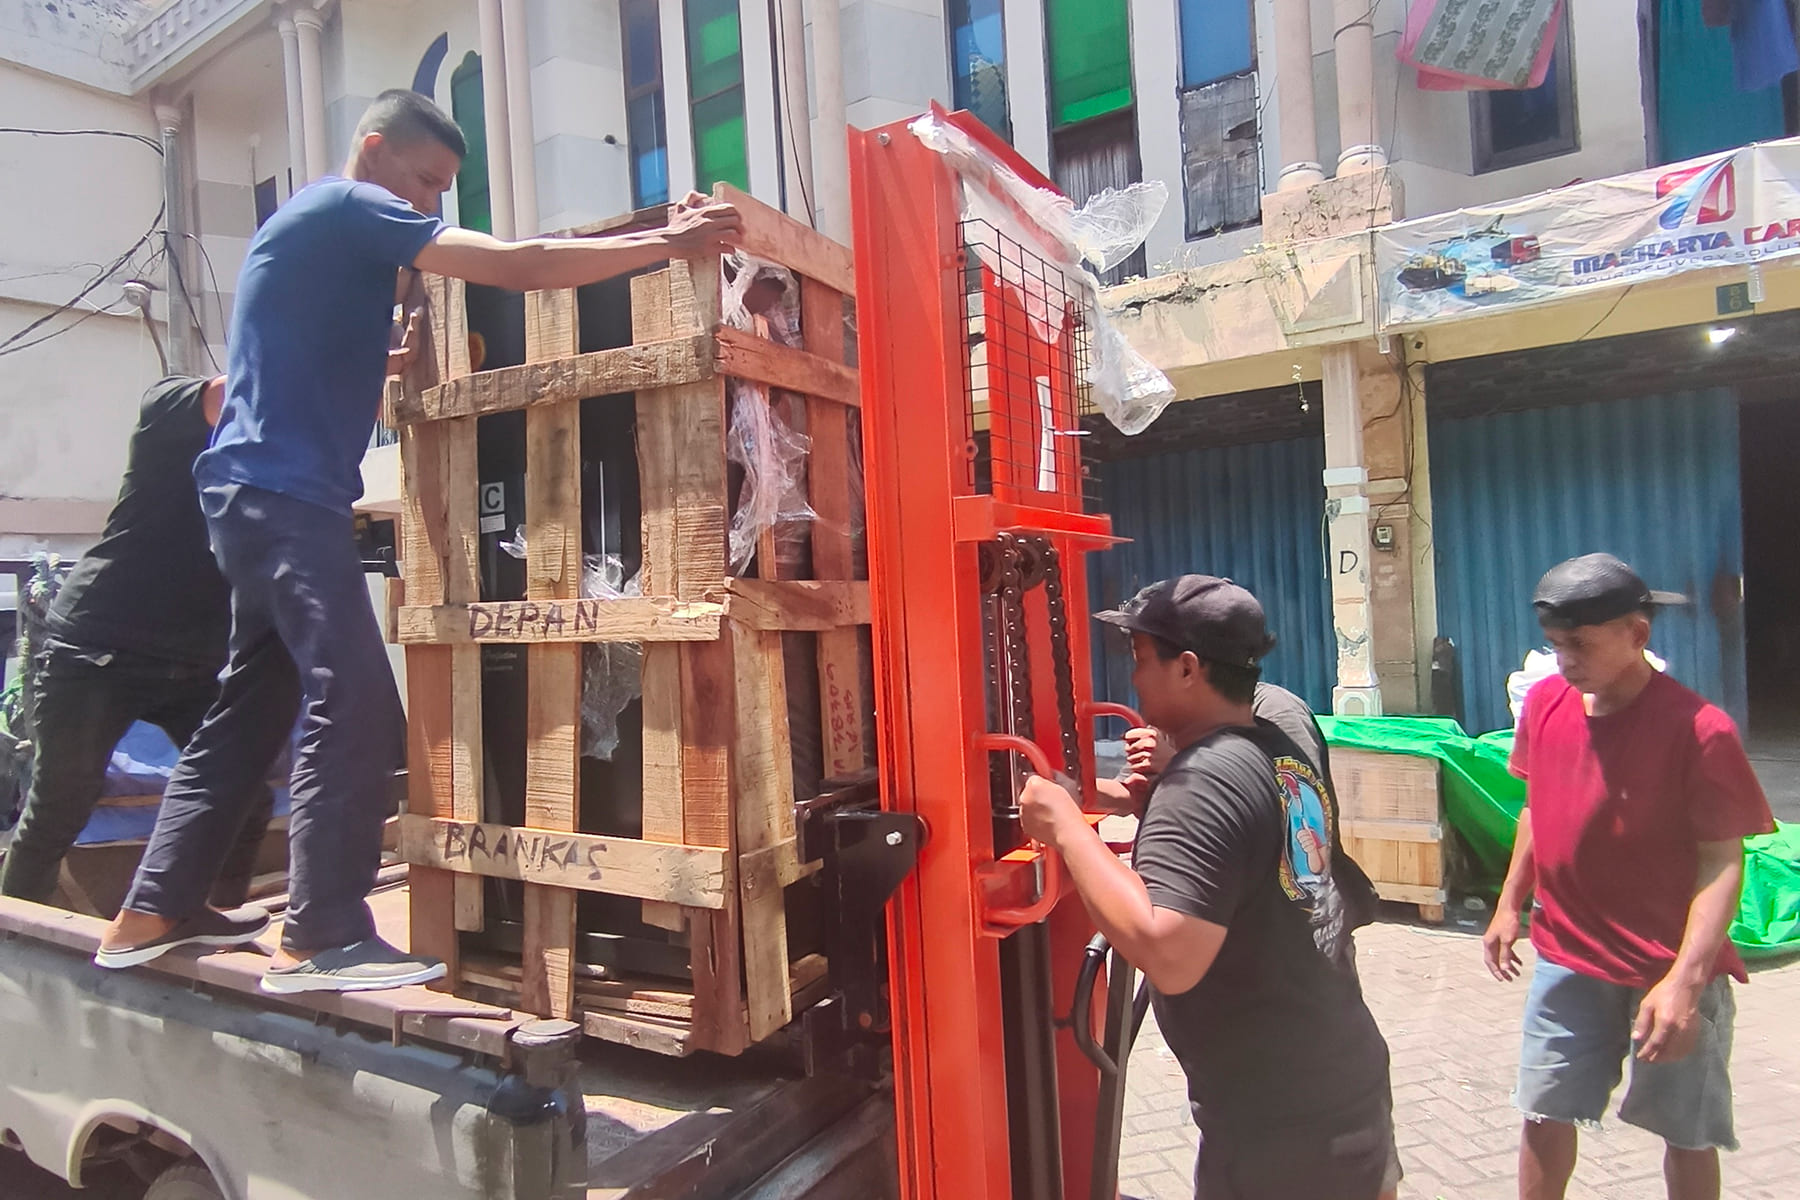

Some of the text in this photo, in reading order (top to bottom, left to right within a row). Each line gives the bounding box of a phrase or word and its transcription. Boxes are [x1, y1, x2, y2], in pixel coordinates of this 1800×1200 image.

[485, 486, 500, 509] C
[1339, 550, 1358, 574] D
[469, 600, 600, 638] DEPAN
[444, 822, 608, 881] BRANKAS
